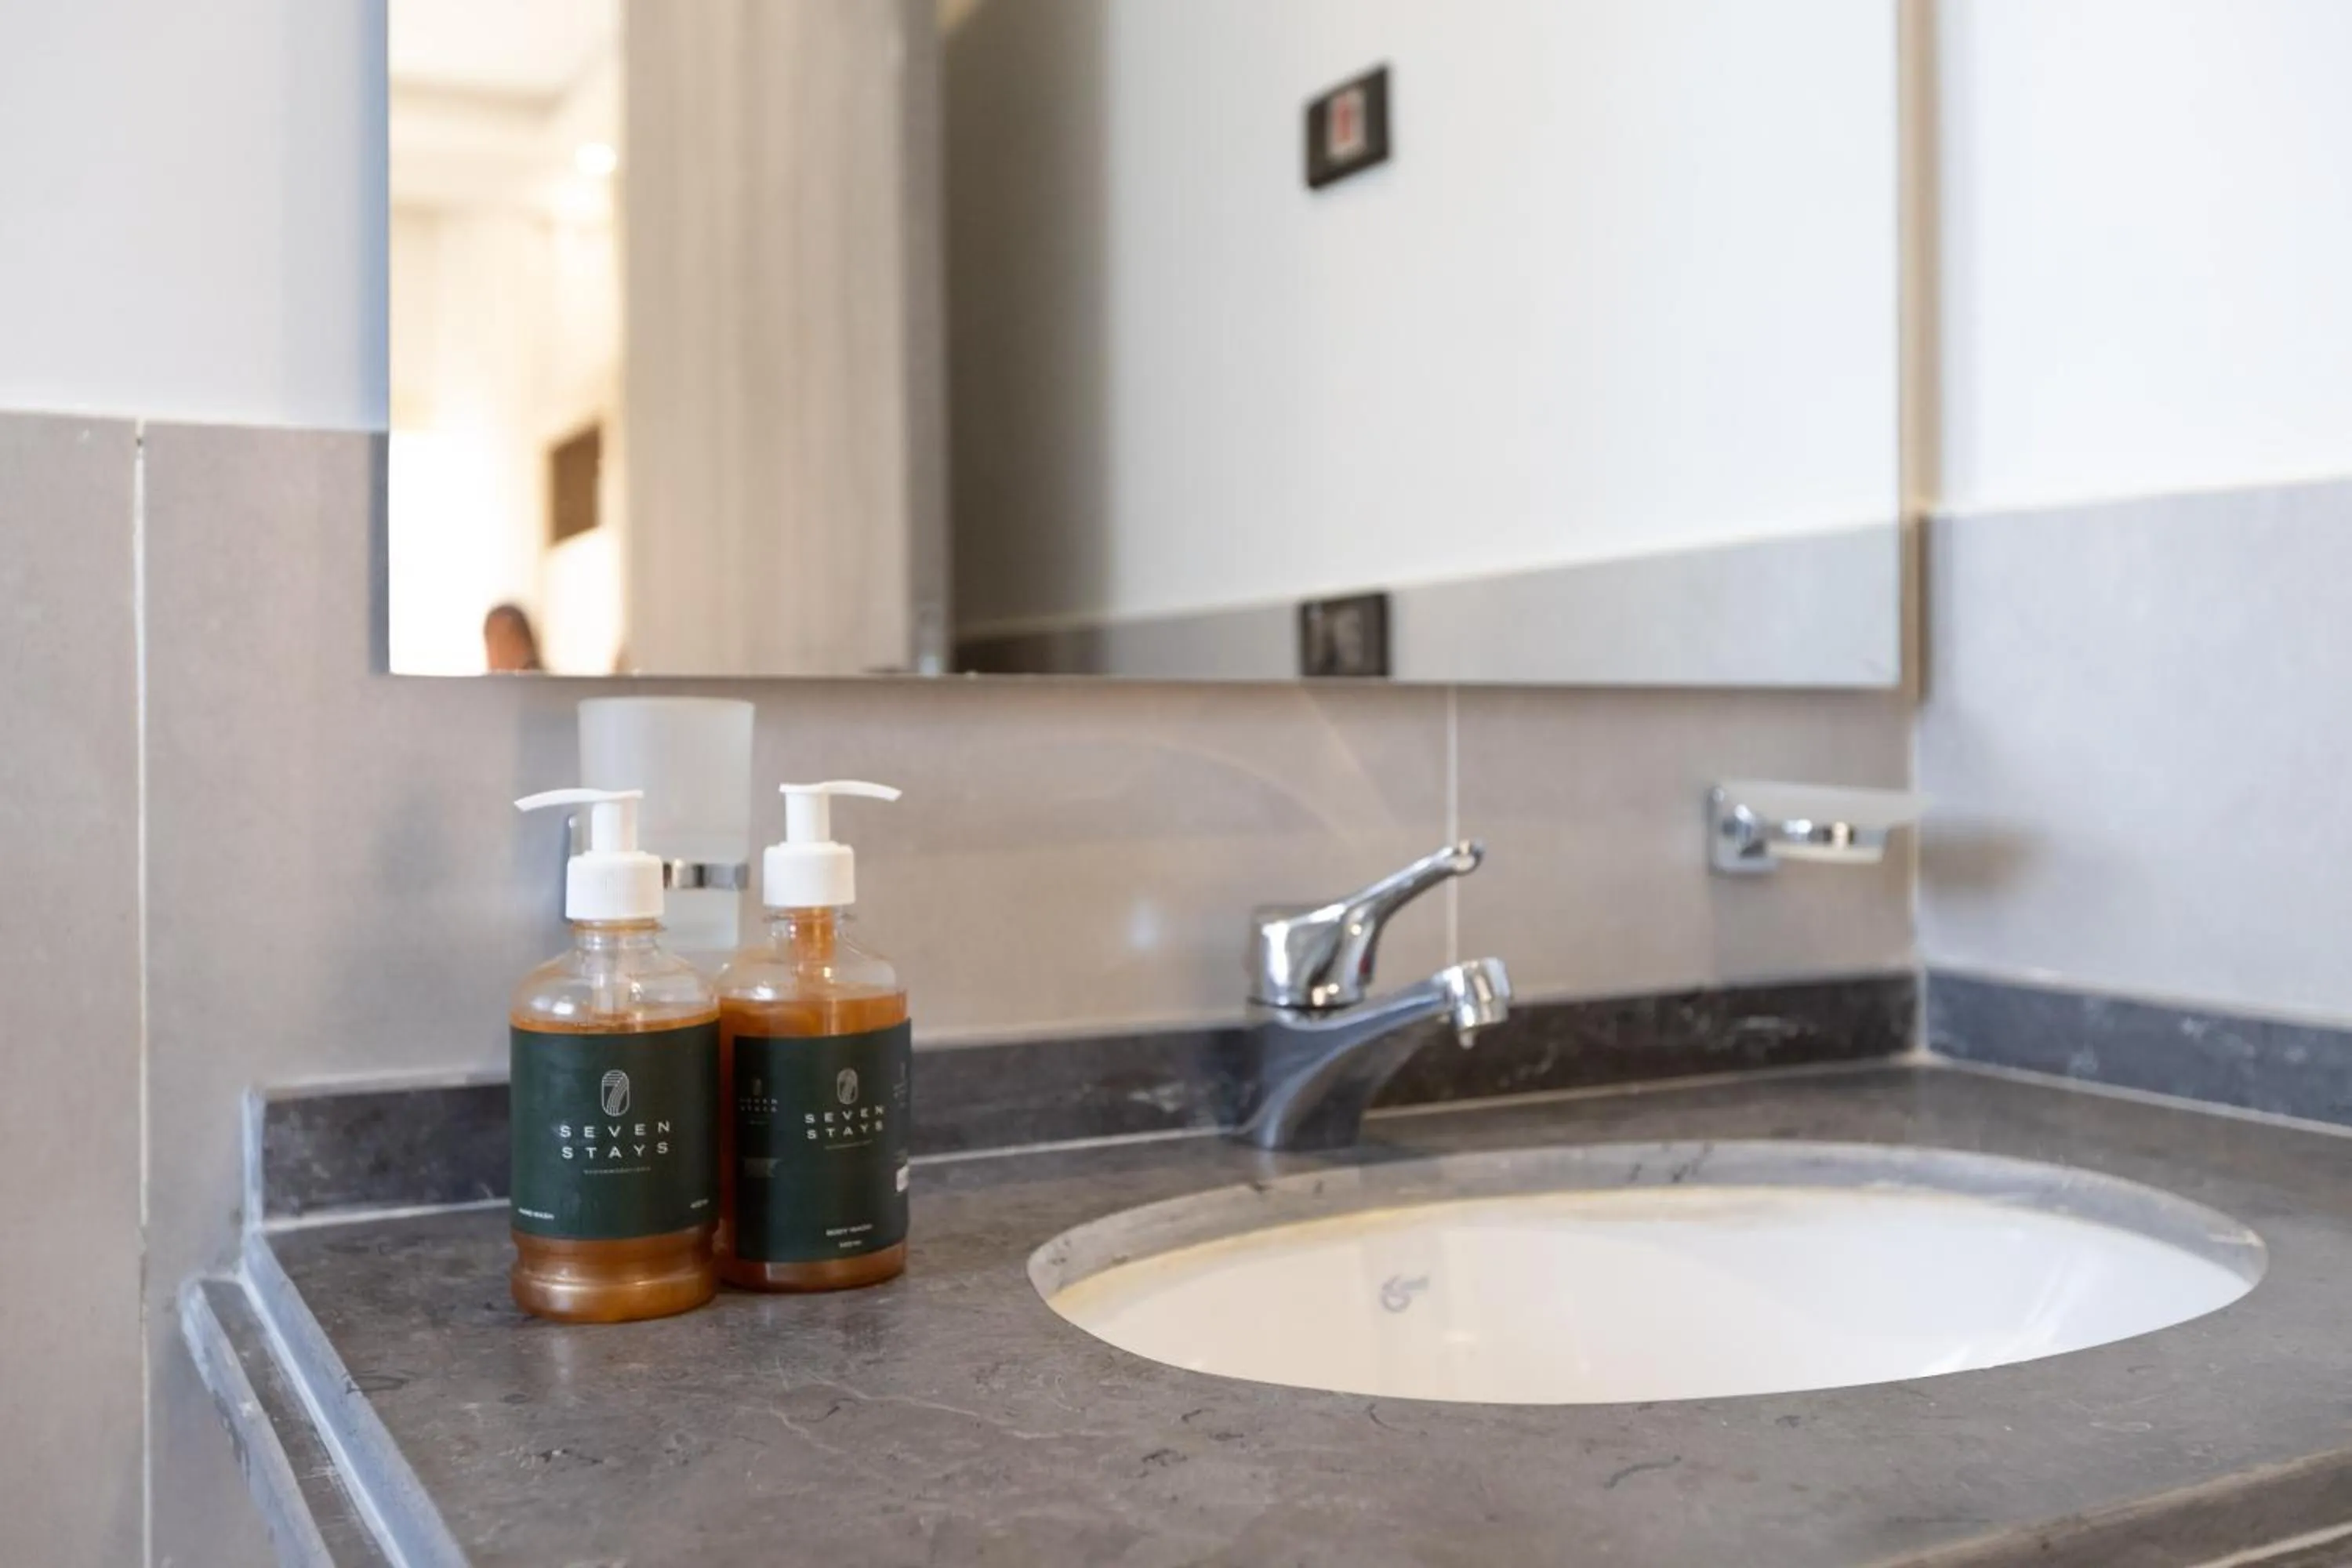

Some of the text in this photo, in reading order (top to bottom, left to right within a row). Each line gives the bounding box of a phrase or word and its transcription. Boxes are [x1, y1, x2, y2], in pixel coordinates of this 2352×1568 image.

[804, 1105, 884, 1123] SEVEN
[560, 1121, 670, 1138] SEVEN
[807, 1120, 883, 1139] STAYS
[561, 1142, 668, 1159] STAYS
